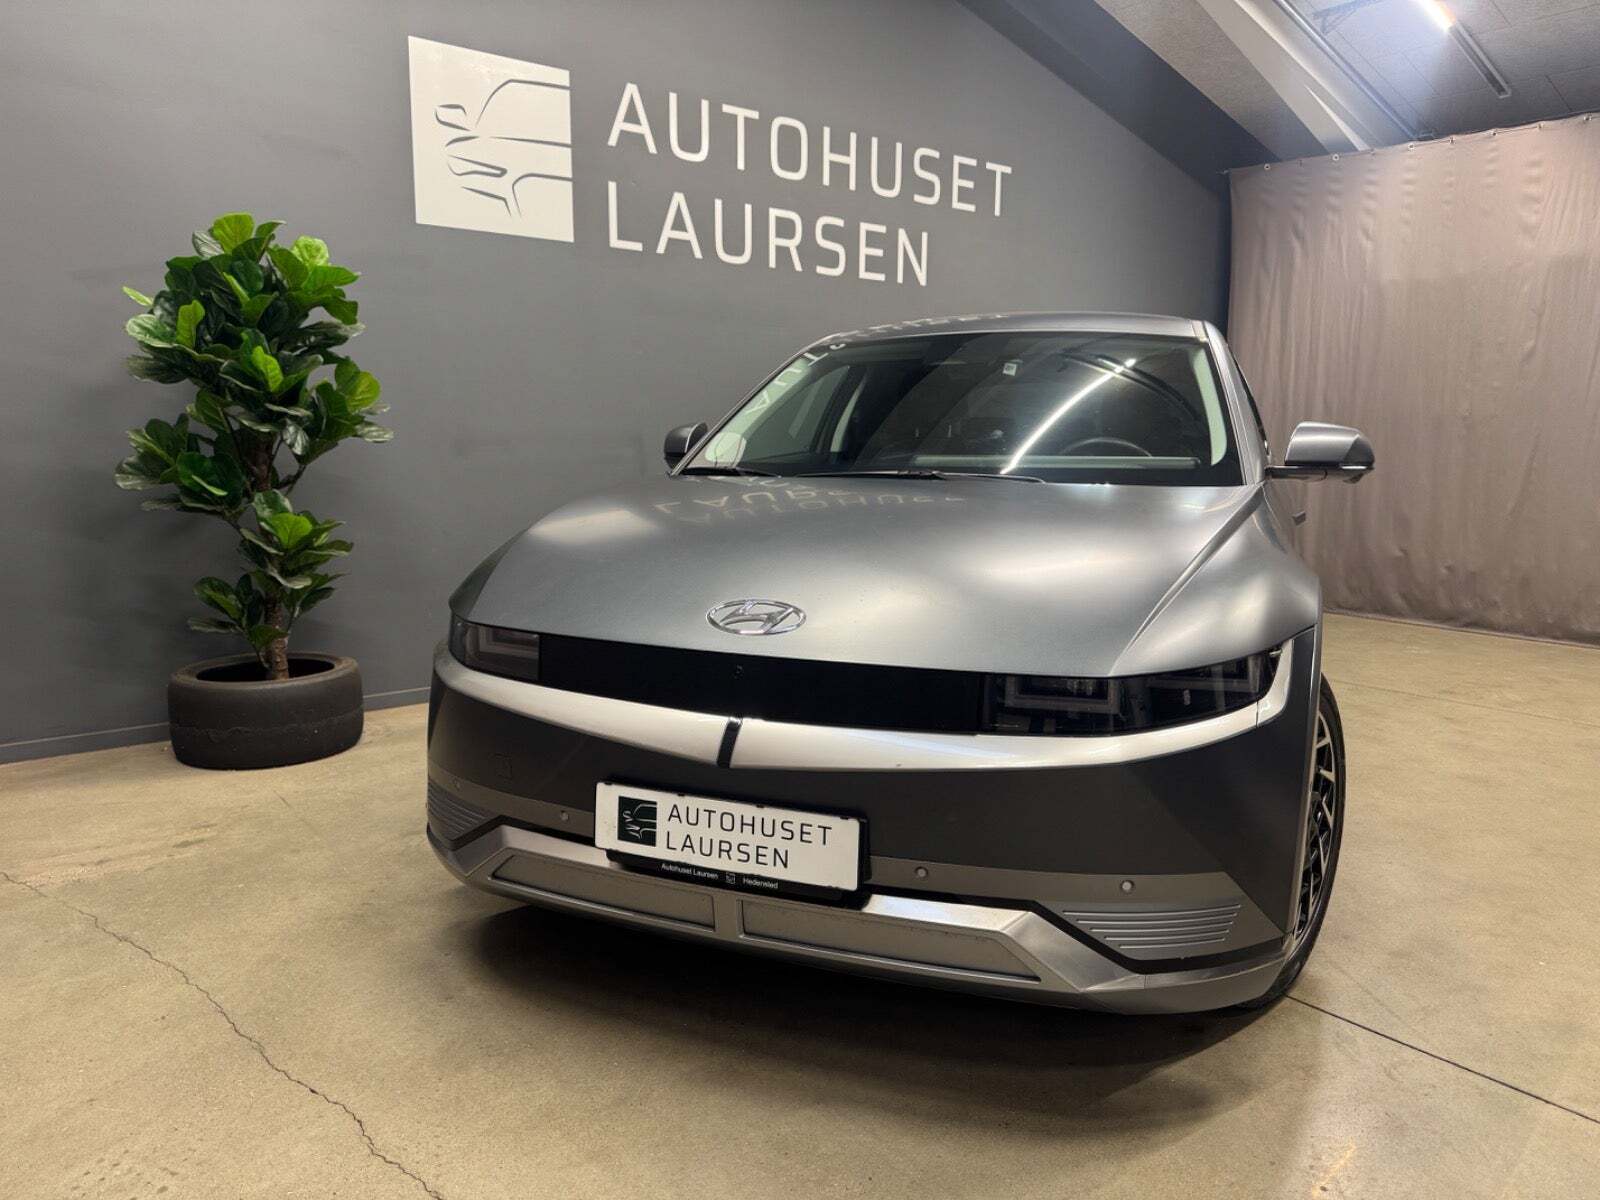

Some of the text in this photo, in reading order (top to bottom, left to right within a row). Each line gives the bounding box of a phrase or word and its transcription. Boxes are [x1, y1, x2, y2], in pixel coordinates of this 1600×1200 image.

[607, 83, 1012, 217] AUTOHUSET
[608, 181, 929, 286] LAURSEN
[668, 804, 832, 845] AUTOHUSET
[666, 831, 788, 868] LAURSEN
[661, 863, 692, 875] Autohuset
[693, 868, 719, 879] Laursen
